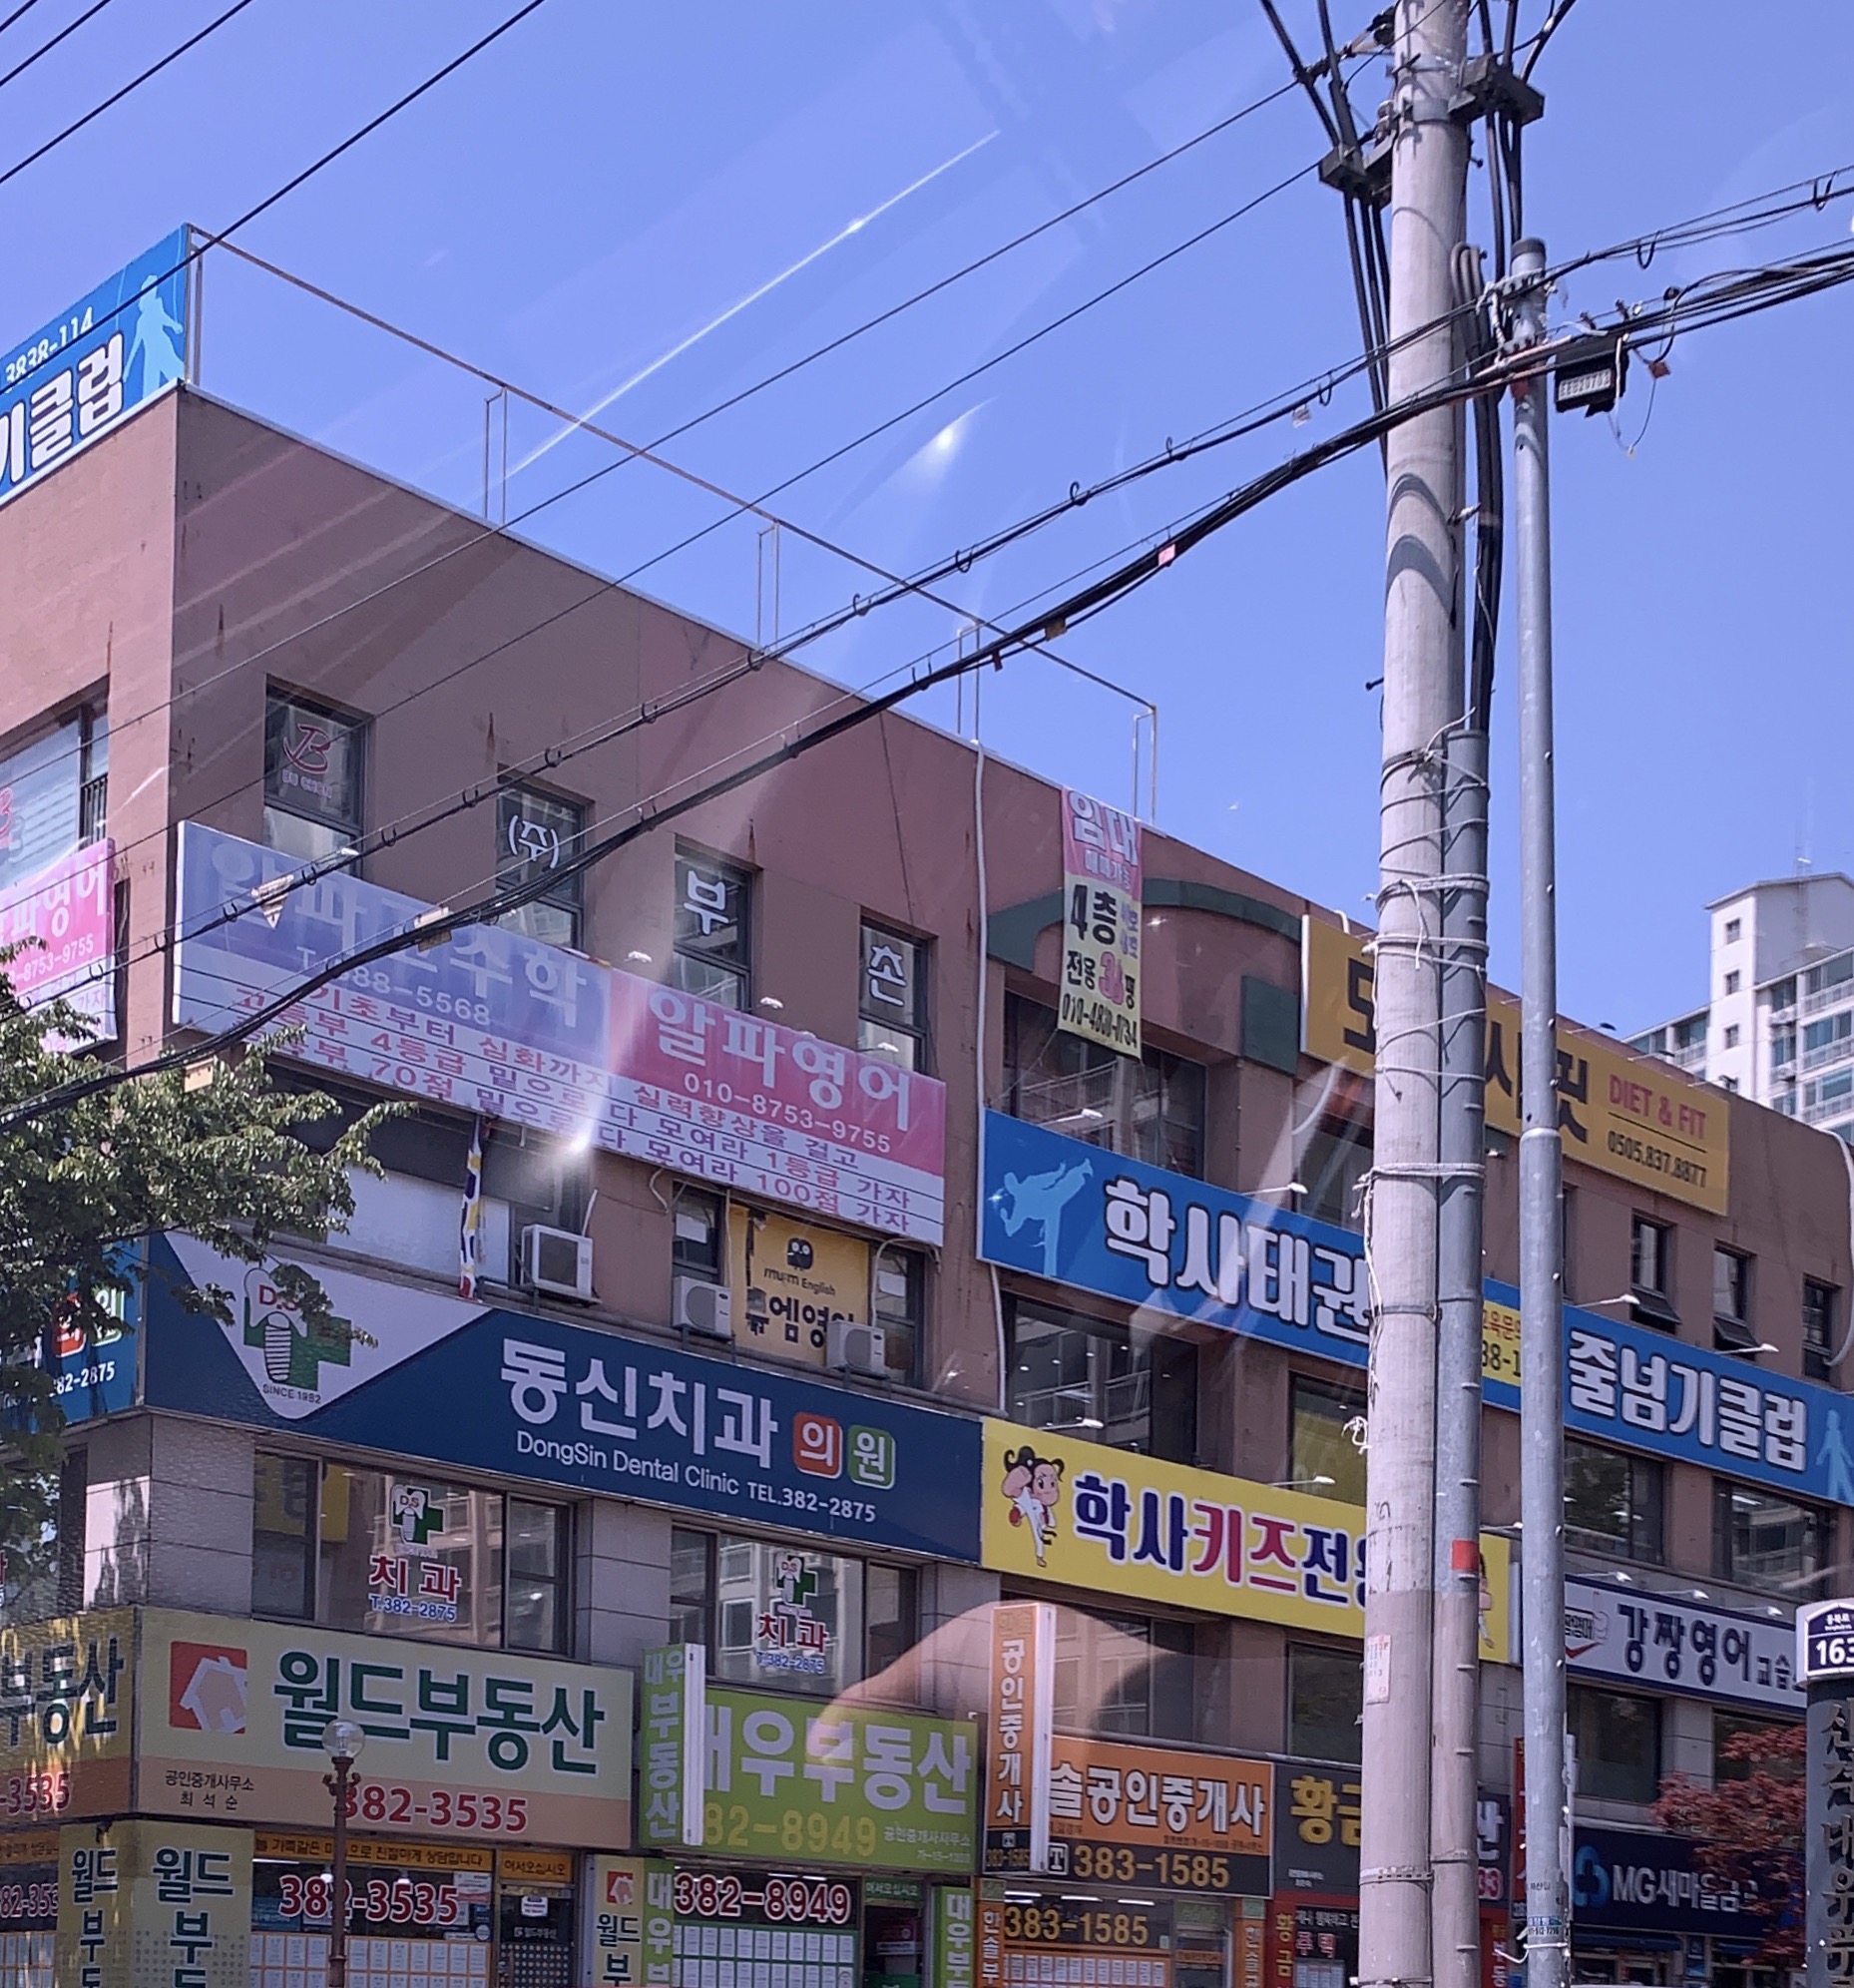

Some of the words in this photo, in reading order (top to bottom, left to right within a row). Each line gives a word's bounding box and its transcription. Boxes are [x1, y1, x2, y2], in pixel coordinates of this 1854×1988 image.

[1069, 790, 1138, 866] 임대
[0, 853, 107, 943] 파영어
[508, 814, 560, 870] (주)
[683, 870, 732, 936] 부
[1071, 884, 1117, 945] 4층
[338, 964, 491, 1026] 88-5568
[1067, 950, 1096, 990] 전용
[650, 992, 909, 1131] 알파영어
[370, 1032, 466, 1075] 4등급
[610, 1104, 638, 1127] 다
[656, 1119, 747, 1160] 모여라
[767, 1153, 839, 1188] 1등급
[858, 1180, 910, 1209] 가자
[478, 1037, 614, 1095] 심화까지
[634, 1085, 788, 1148] 실력향상을
[805, 1139, 859, 1169] 걸고
[685, 1073, 890, 1154] 010-8753-9755
[1610, 1074, 1652, 1117] DIET
[1658, 1096, 1672, 1127] &
[1678, 1103, 1706, 1140] FIT
[371, 1058, 452, 1099] 70점
[600, 1127, 627, 1149] 다
[646, 1140, 738, 1182] 모여라
[756, 1174, 838, 1215] 100점
[856, 1207, 910, 1233] 가자
[746, 1296, 854, 1348] 엠영
[262, 1383, 293, 1399] SINCE
[500, 1338, 778, 1469] 동신치과
[1568, 1330, 1807, 1472] 줄넘기클럽
[516, 1430, 607, 1468] DongSin
[613, 1448, 679, 1484] Dental
[685, 1465, 739, 1495] Clinic
[747, 1482, 876, 1523] TEL.382-2875
[368, 1554, 462, 1604] 치과
[368, 1593, 457, 1622] T.382-2875
[757, 1612, 829, 1656] 치과
[1617, 1603, 1751, 1687] 강짱영어
[274, 1650, 606, 1775] 월드부동산
[997, 1638, 1025, 1824] 공인중개사
[165, 1769, 254, 1791] 공인중개사무소
[647, 1691, 680, 1838] 부동산
[1050, 1760, 1264, 1836] 솔공인중개사
[674, 1872, 851, 1925] 382-8949
[1074, 1844, 1231, 1888] 383-1585
[946, 1893, 972, 1988] 대우부
[1005, 1905, 1150, 1946] 383-1585
